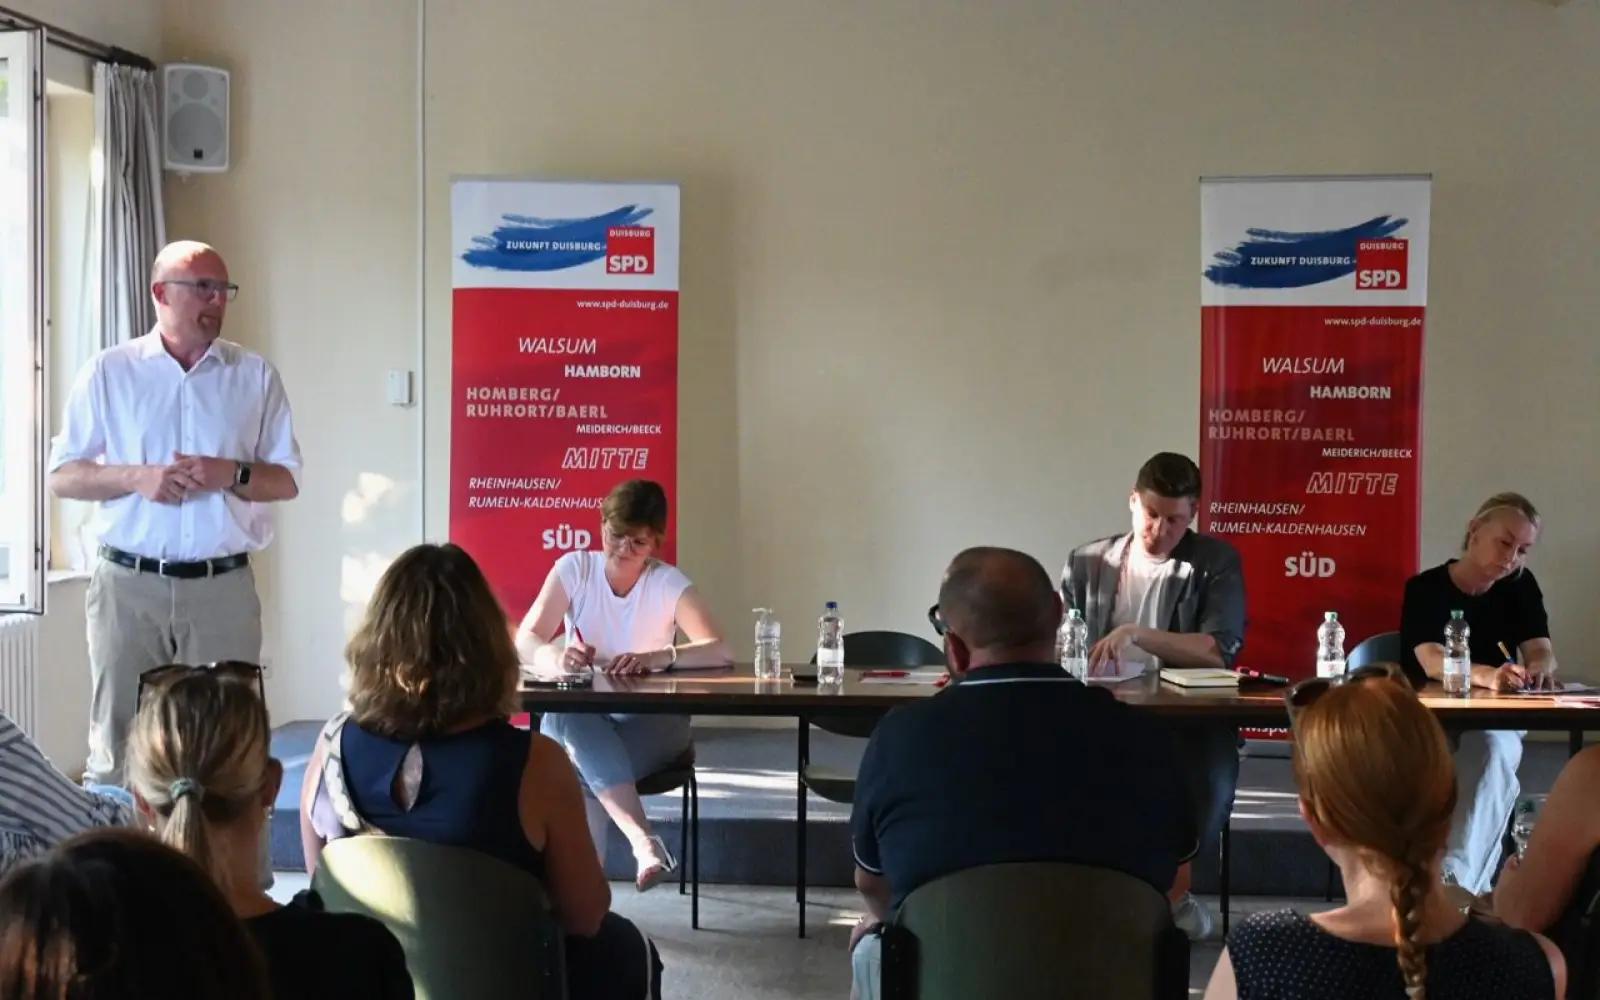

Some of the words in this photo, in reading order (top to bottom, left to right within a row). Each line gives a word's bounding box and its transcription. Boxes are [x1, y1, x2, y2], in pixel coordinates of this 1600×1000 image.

[609, 229, 651, 238] DUISBURG
[506, 240, 550, 250] ZUKUNFT
[552, 241, 601, 251] DUISBURG
[1359, 242, 1405, 251] DUISBURG
[609, 255, 648, 272] SPD
[1250, 256, 1297, 266] ZUKUNFT
[1299, 256, 1351, 266] DUISBURG
[1359, 269, 1401, 288] SPD
[576, 299, 669, 311] www.spd-duisburg.de
[1324, 316, 1422, 328] www.spd-duisburg.de
[519, 337, 597, 355] WALSUM
[564, 364, 641, 378] HAMBORN
[1262, 357, 1345, 374] WALSUM
[466, 386, 561, 402] HOMBERG/
[1310, 385, 1391, 399] HAMBORN
[465, 403, 608, 419] RUHRORT/BAERL
[1208, 409, 1306, 423] HOMBERG/
[576, 423, 661, 435] MEIDERICH/BEECK
[1208, 427, 1355, 441] RUHRORT/BAERL
[561, 447, 649, 470] MITTE
[1321, 447, 1413, 459] MEIDERICH/BEECK
[468, 477, 562, 490] RHEINHAUSEN/
[1305, 471, 1400, 496] MITTE
[468, 496, 603, 509] RUMELN-KALDENHAUS
[1209, 502, 1306, 515] RHEINHAUSEN/
[1209, 520, 1367, 536] RUMELN-KALDENHAUSEN
[542, 524, 591, 550] SÜD
[1284, 551, 1336, 578] SÜD
